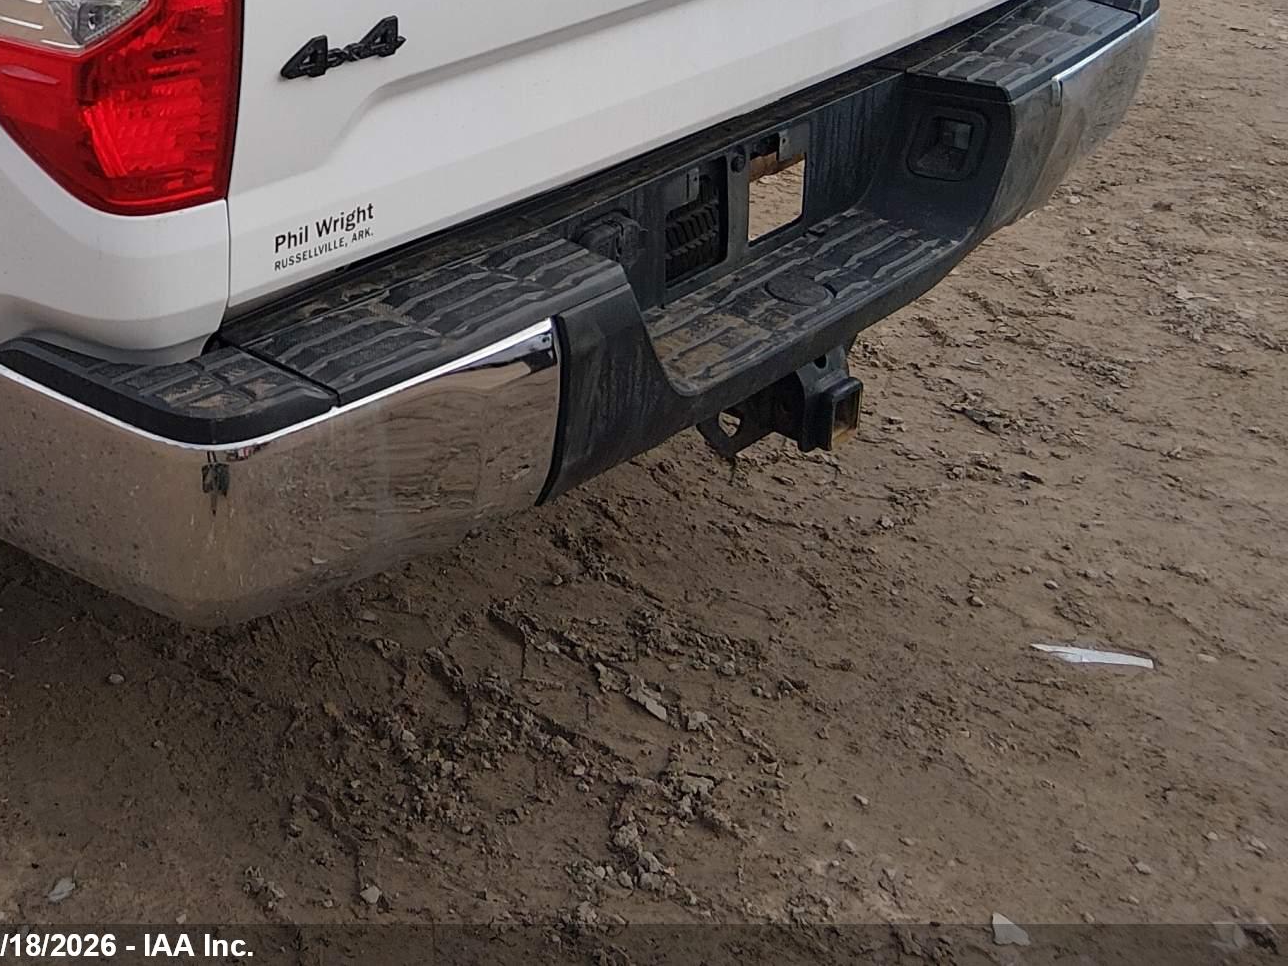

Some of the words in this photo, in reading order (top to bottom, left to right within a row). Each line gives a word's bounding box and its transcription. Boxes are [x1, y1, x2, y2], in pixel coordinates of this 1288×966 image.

[280, 15, 407, 79] 4x4
[274, 225, 308, 253] Phil
[315, 202, 374, 237] Wright
[274, 236, 348, 271] RUSSELLVILLE,
[351, 227, 374, 242] ARK.
